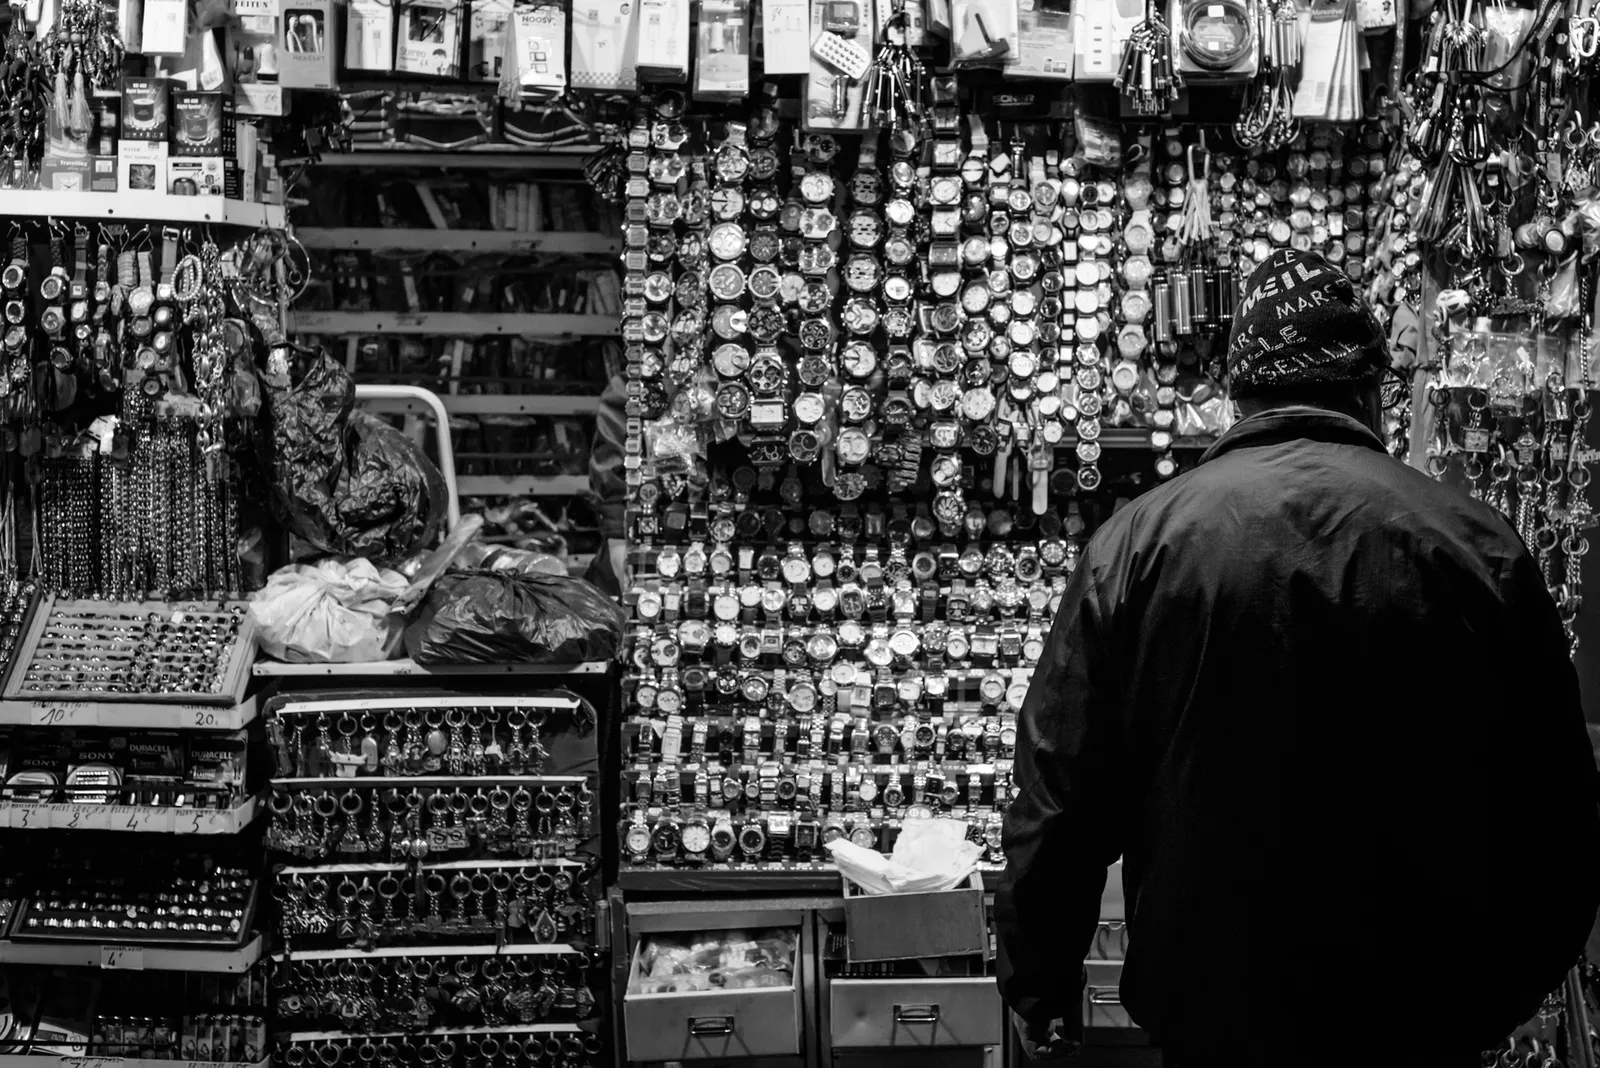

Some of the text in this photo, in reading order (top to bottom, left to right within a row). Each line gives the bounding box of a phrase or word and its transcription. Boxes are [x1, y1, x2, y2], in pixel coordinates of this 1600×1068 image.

[129, 744, 170, 752] DURACELL
[79, 752, 116, 760] SONY
[191, 751, 234, 760] DURACELL
[23, 759, 59, 767] SONY
